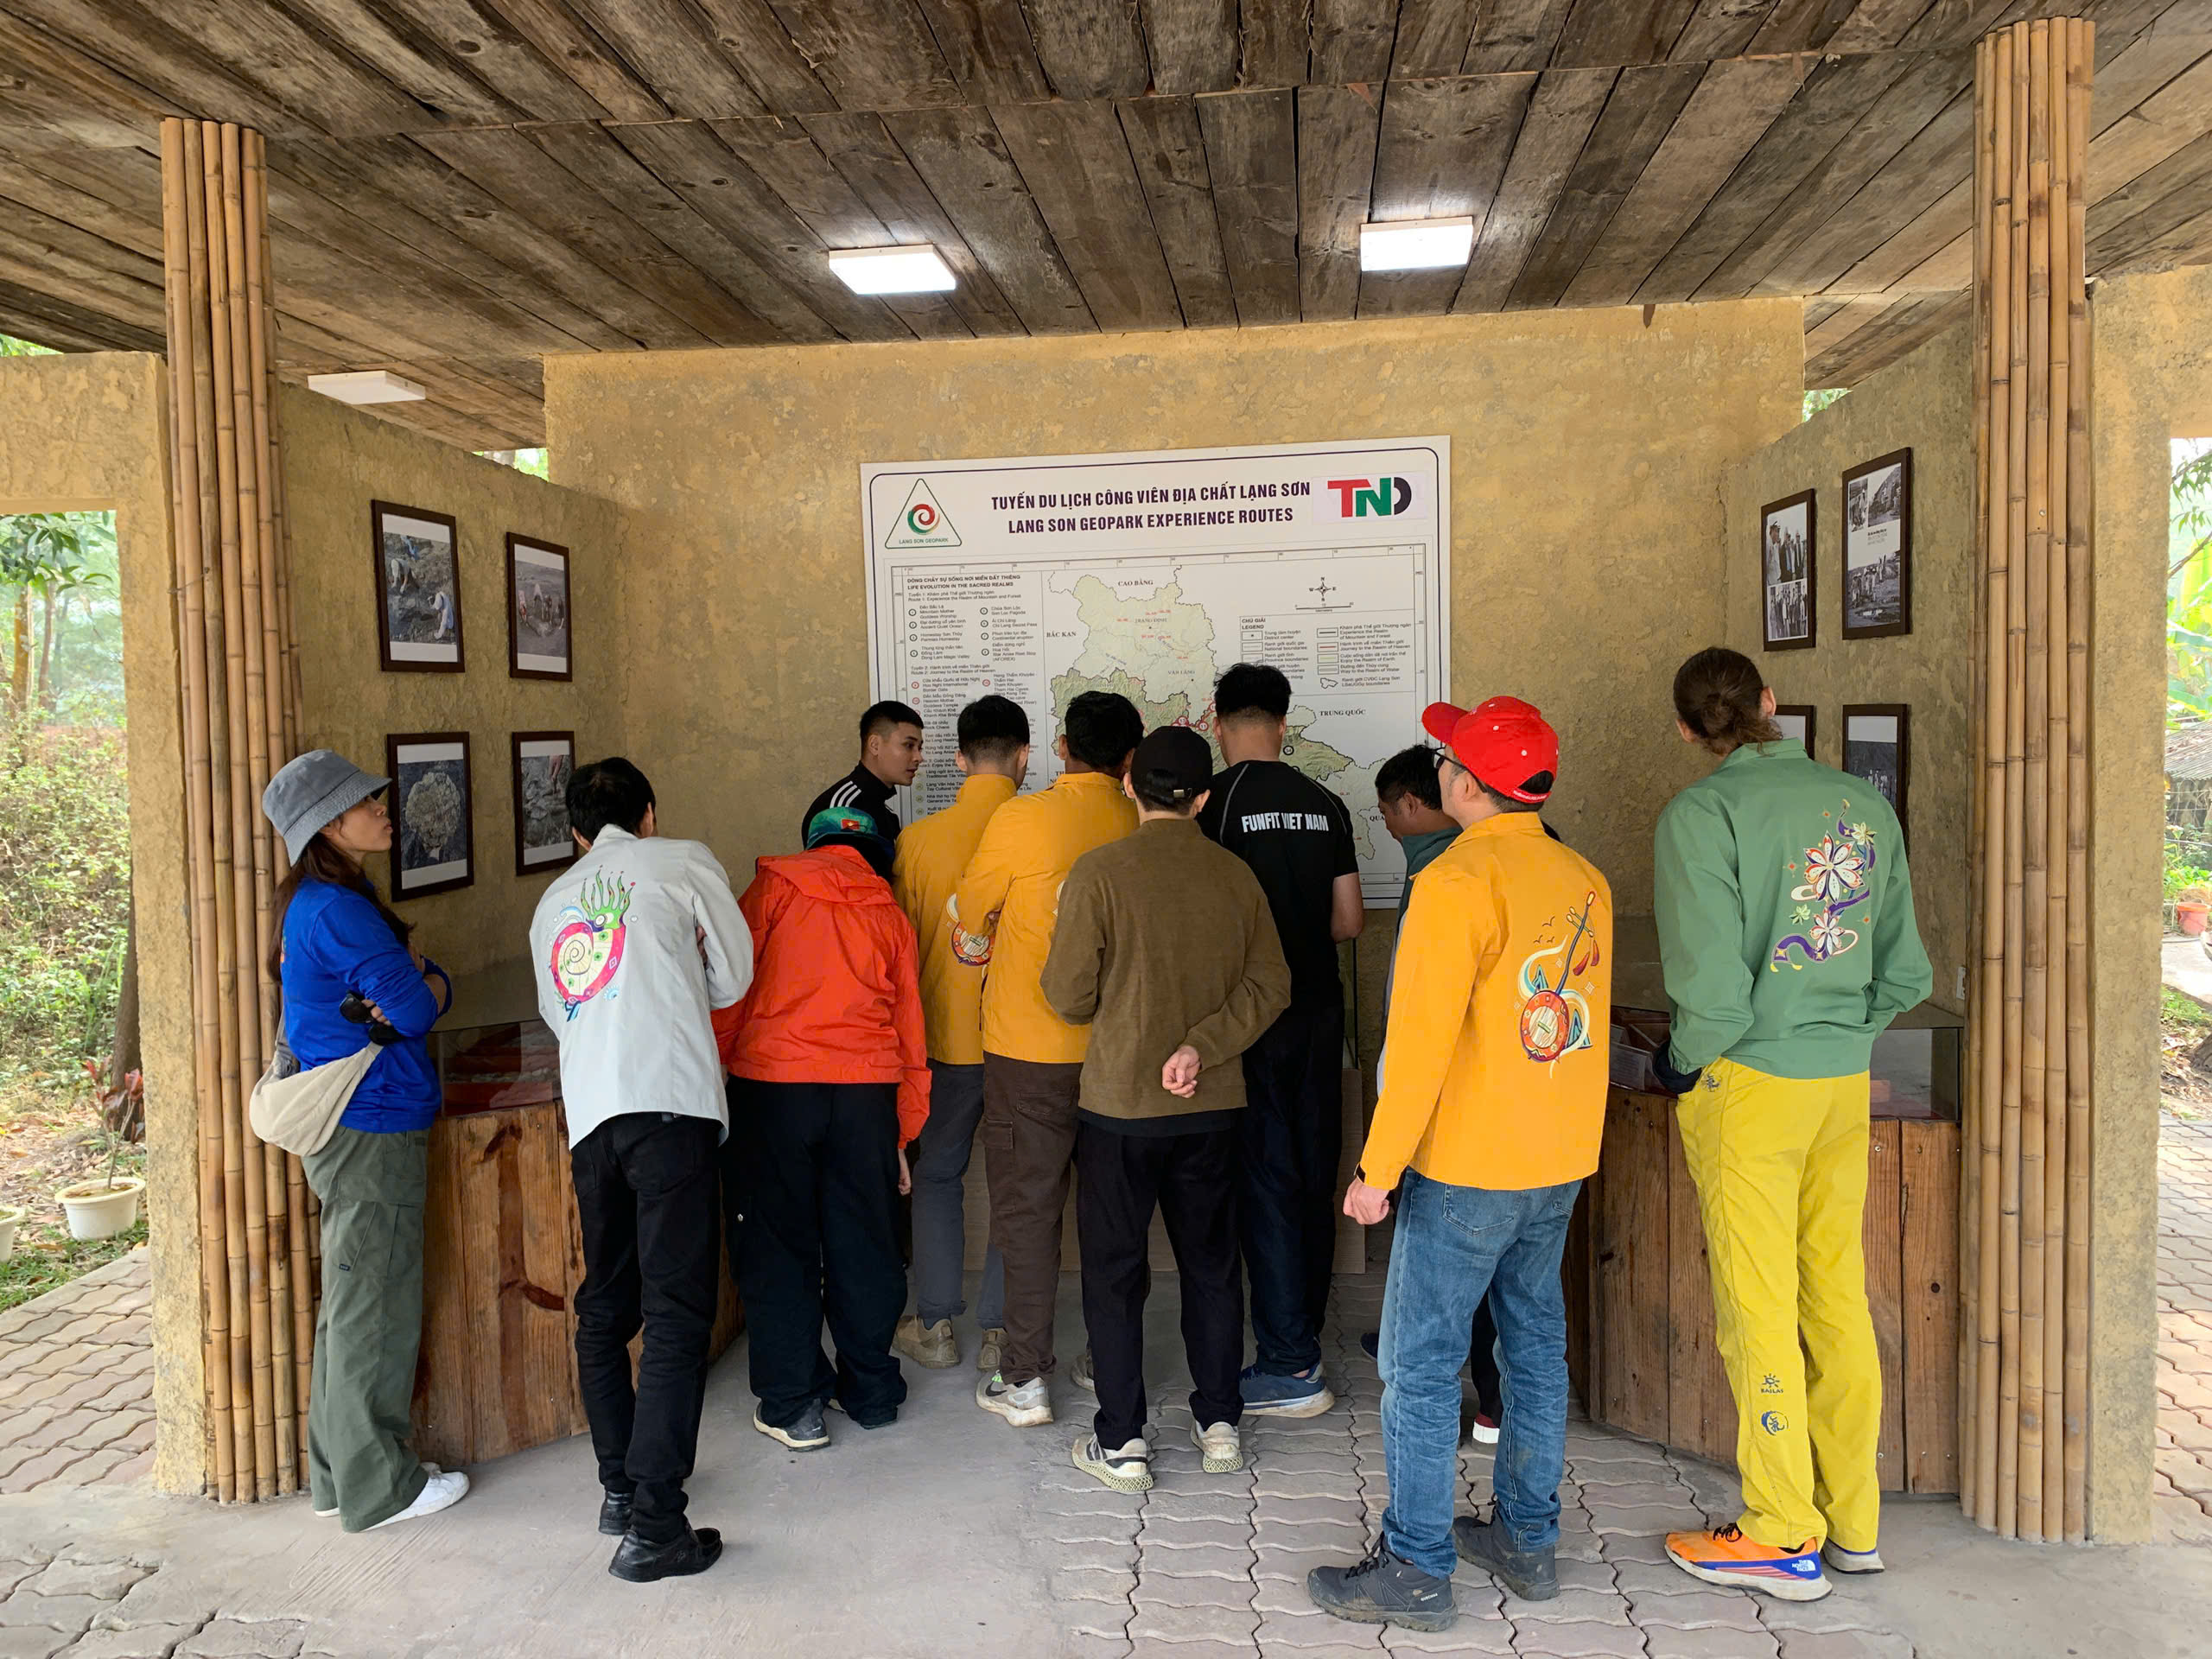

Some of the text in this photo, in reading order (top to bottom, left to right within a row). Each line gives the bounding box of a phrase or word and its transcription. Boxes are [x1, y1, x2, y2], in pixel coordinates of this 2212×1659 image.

[992, 480, 1310, 511] TUYẾN DU LỊCH CÔNG VIÊN ĐỊA CHẤT LẠNG SƠN
[1327, 476, 1412, 518] TND
[1008, 507, 1294, 534] LANG SON GEOPARK EXPERIENCE ROUTES
[1241, 811, 1329, 833] FUNFIT VIET NAM
